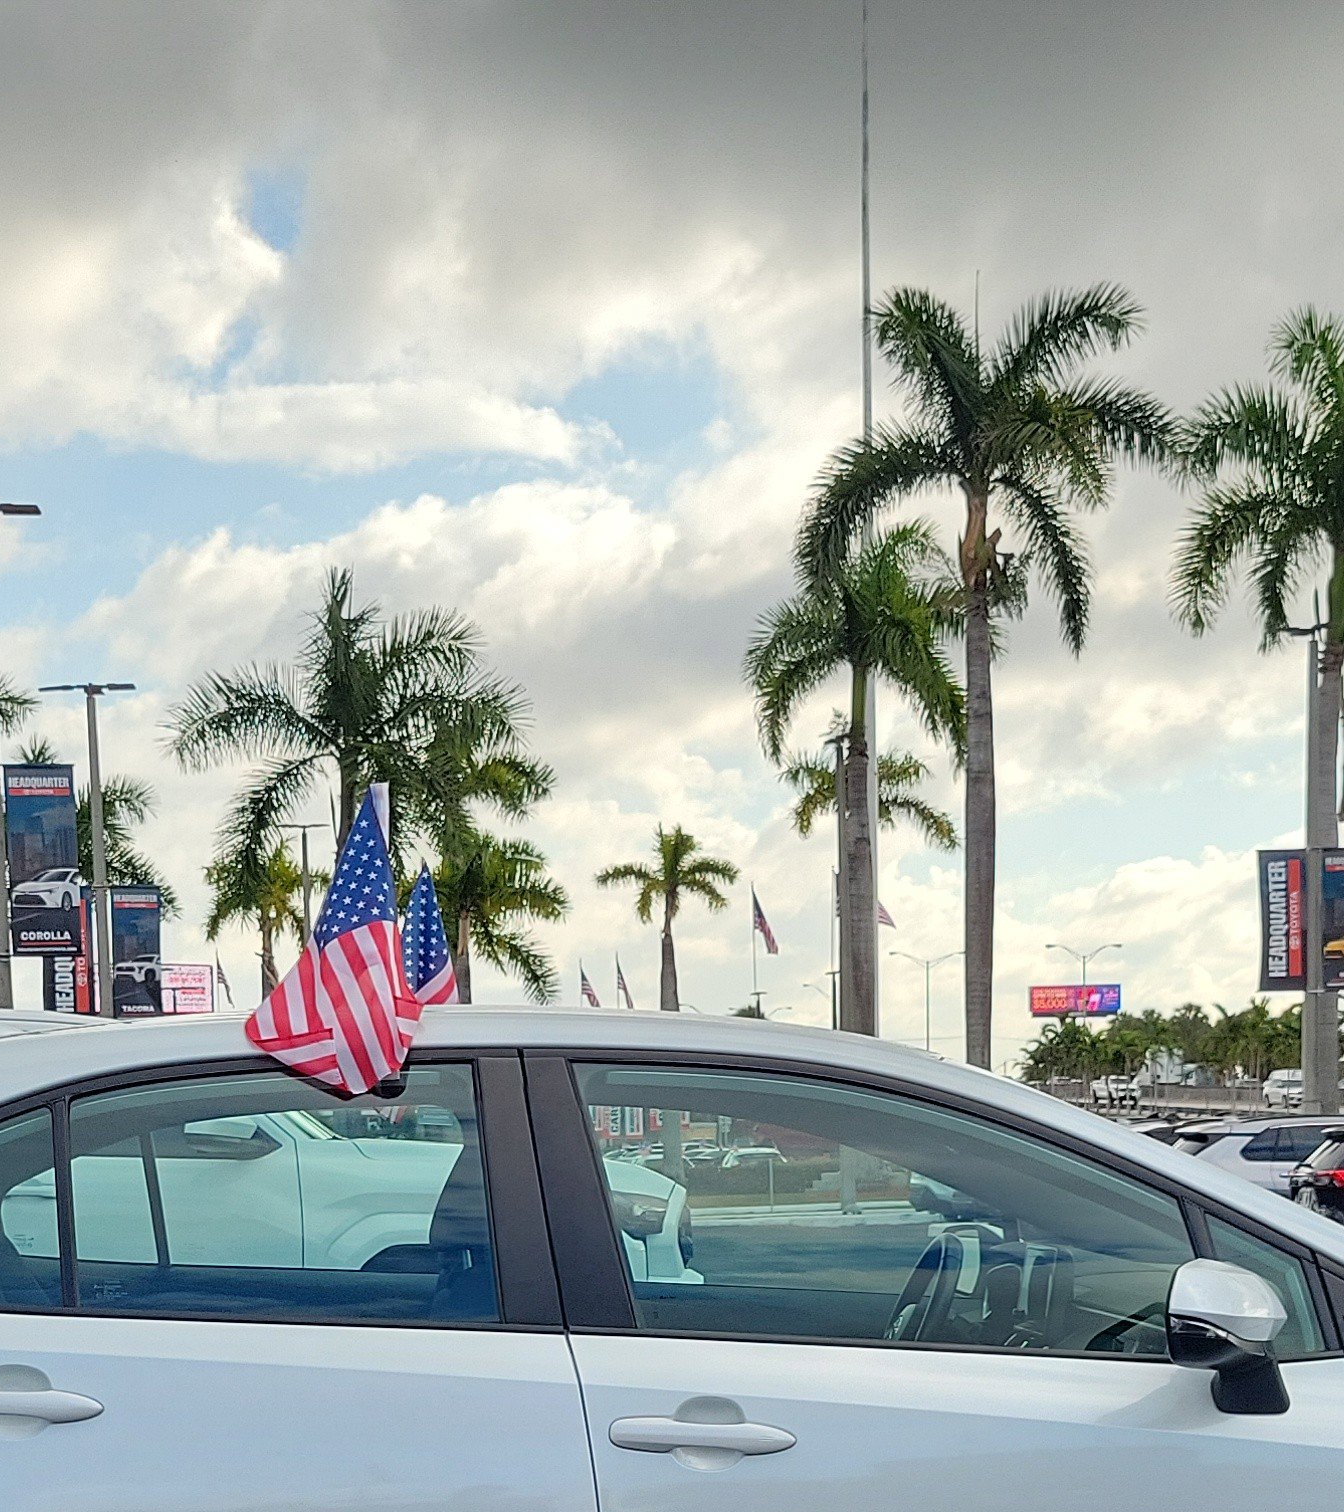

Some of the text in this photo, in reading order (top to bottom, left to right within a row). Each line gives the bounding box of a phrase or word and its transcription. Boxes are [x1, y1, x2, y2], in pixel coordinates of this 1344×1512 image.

[8, 776, 70, 788] HEADQUARTER
[1267, 861, 1288, 977] HEADQUARTER
[20, 931, 71, 940] COROLLA
